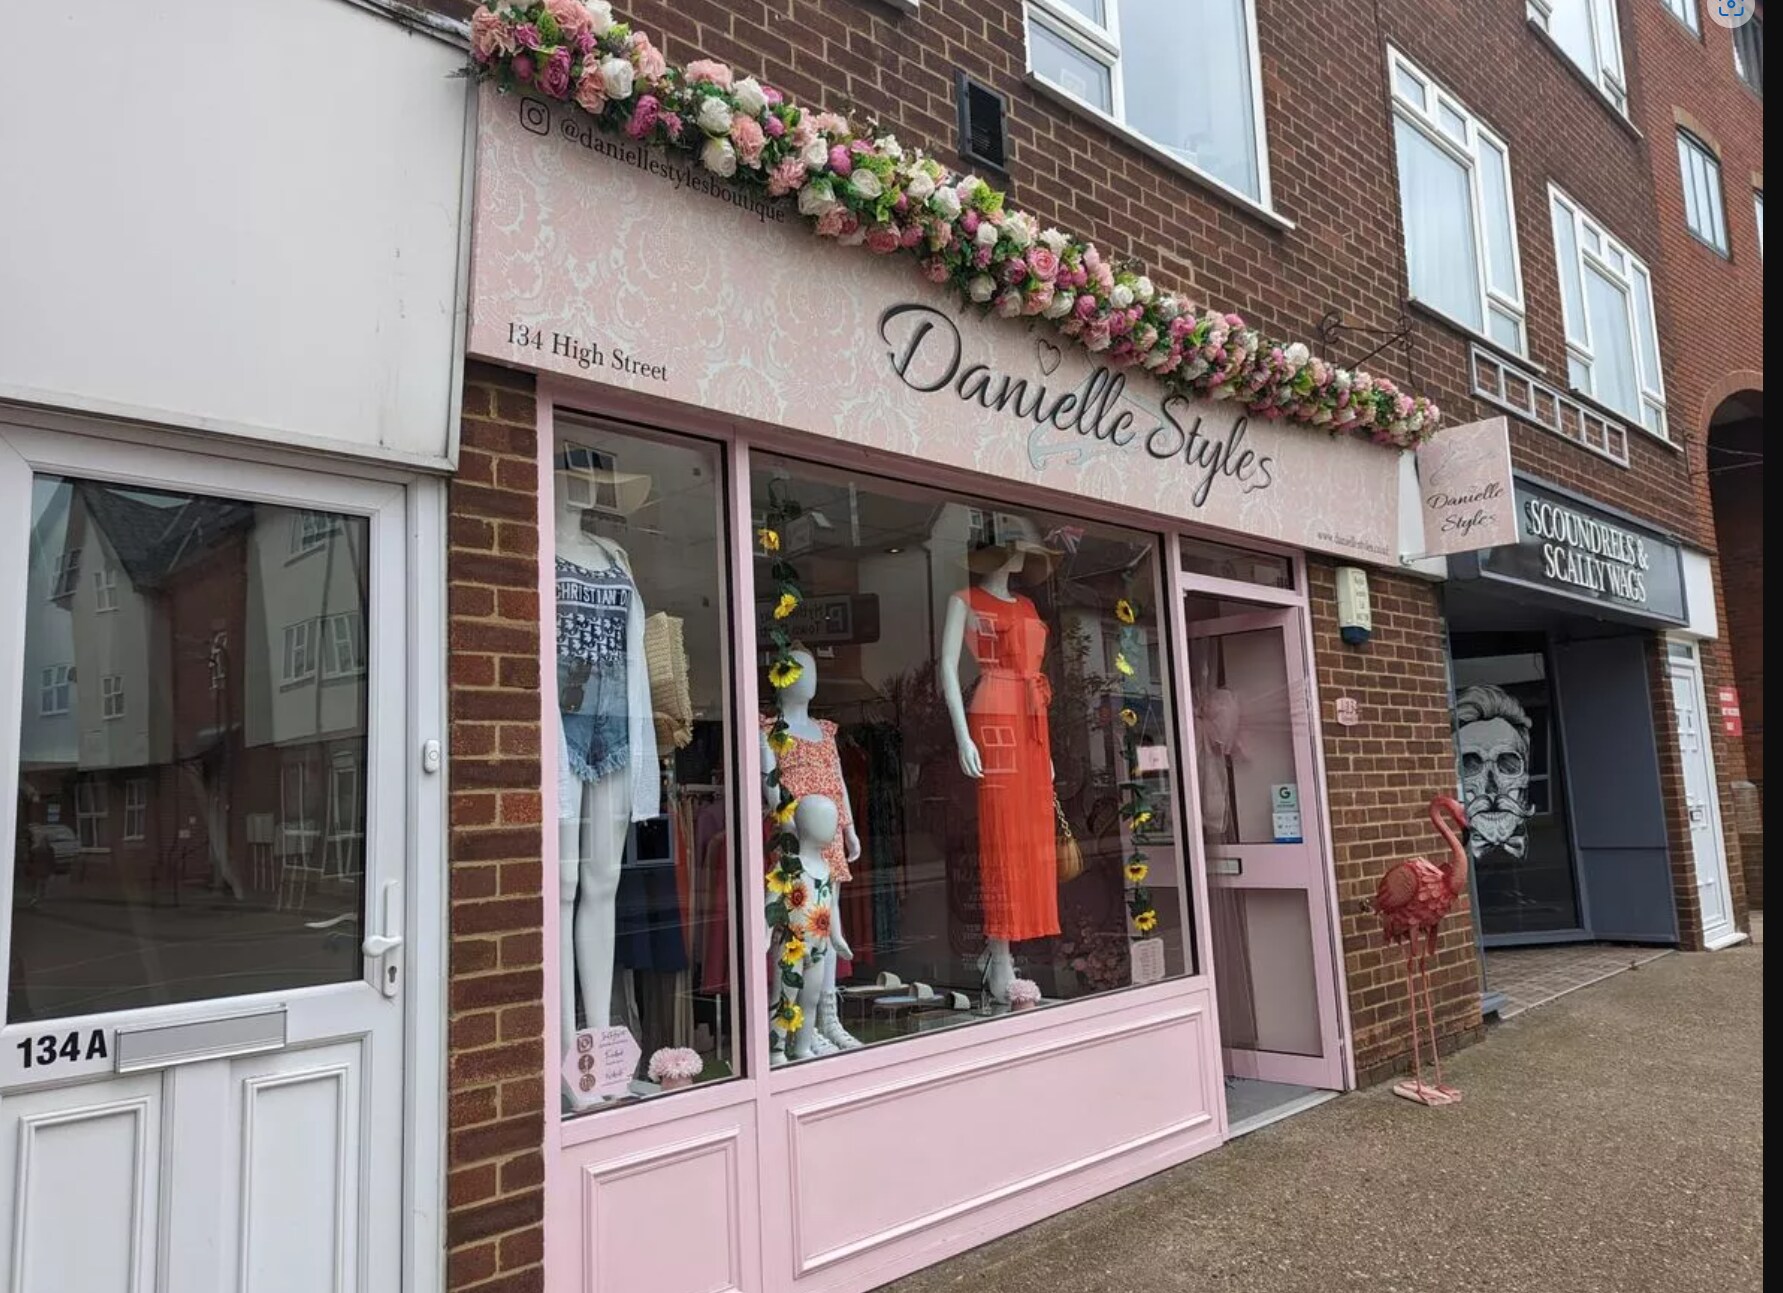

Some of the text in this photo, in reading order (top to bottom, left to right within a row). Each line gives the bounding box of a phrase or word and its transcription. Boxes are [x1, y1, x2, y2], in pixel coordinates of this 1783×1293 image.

[560, 118, 785, 223] @daniellestylesboutique
[506, 322, 668, 382] 134 High Street
[878, 303, 1273, 508] Danielle Styles
[1426, 482, 1503, 509] Danielle
[1441, 509, 1497, 537] Styles
[1530, 499, 1649, 571] SCOUNDRELS &
[17, 1029, 108, 1069] 134A
